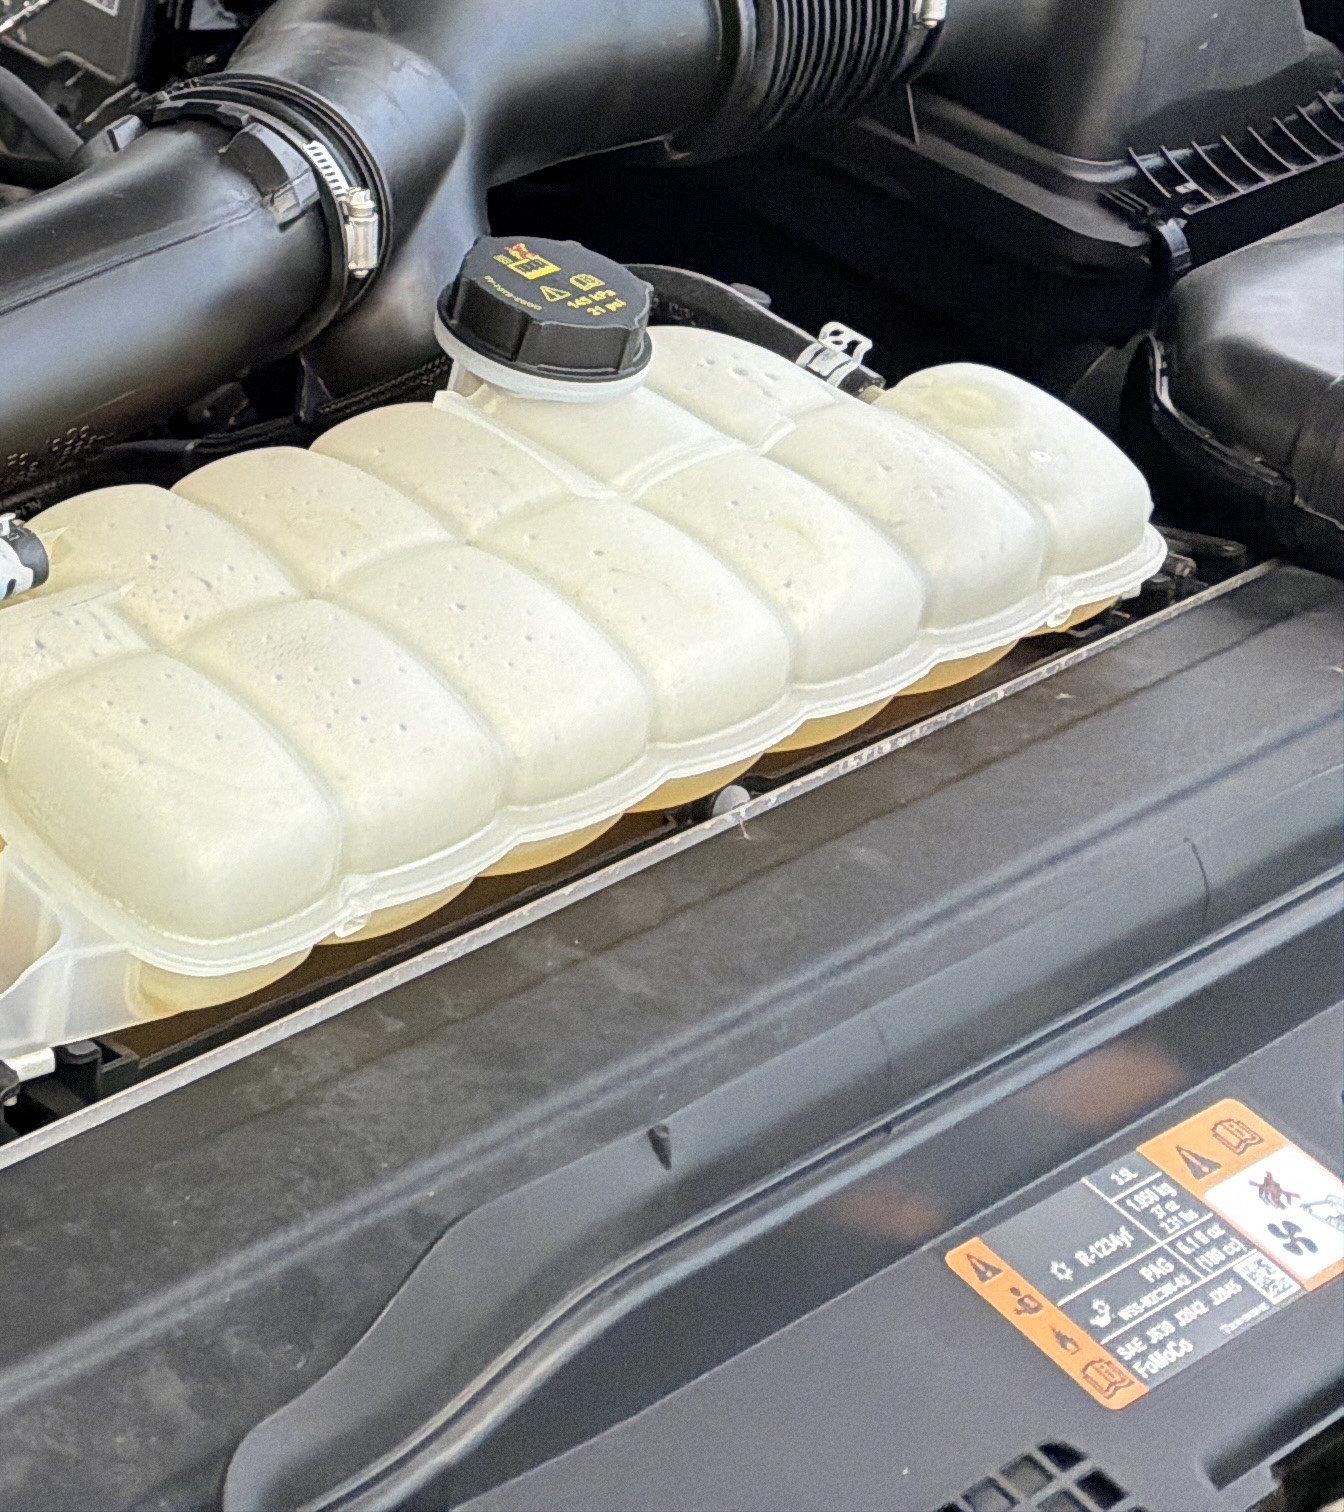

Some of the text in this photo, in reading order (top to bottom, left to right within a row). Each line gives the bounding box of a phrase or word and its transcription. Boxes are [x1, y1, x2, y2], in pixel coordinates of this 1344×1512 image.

[1074, 1225, 1135, 1267] R-1234yf
[1175, 1237, 1196, 1256] 6.1
[1139, 1257, 1175, 1284] PAG
[1116, 1336, 1148, 1361] SAE
[1131, 1338, 1195, 1379] FoMoCo
